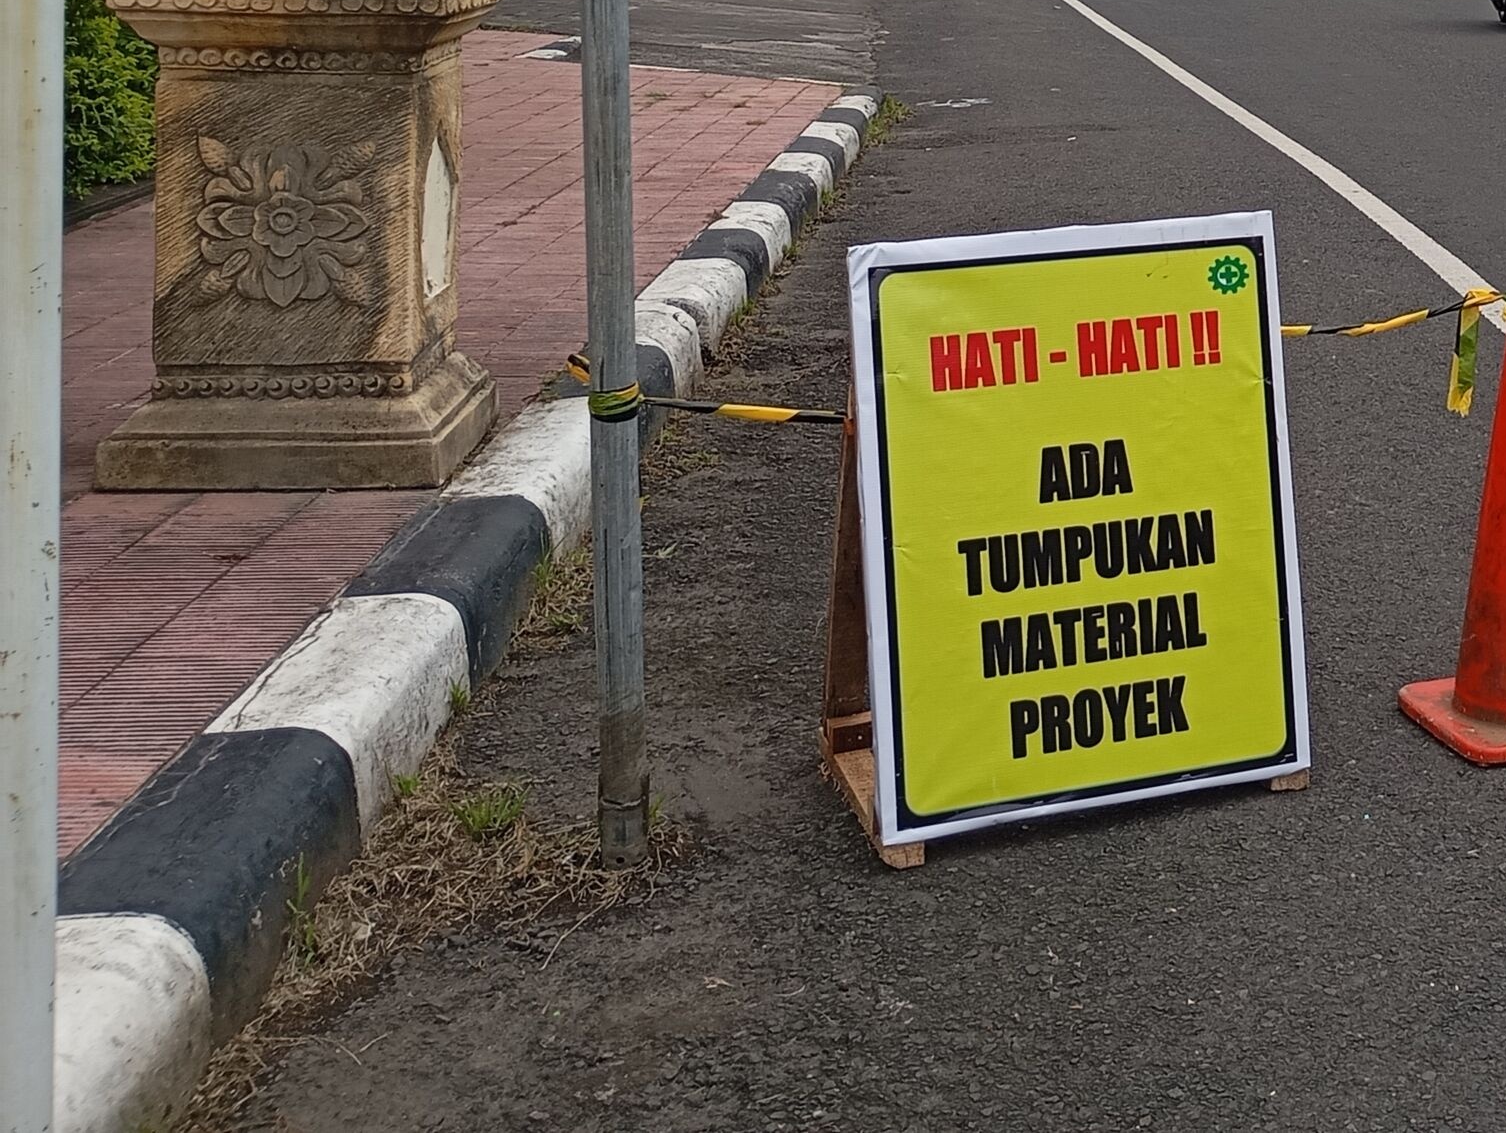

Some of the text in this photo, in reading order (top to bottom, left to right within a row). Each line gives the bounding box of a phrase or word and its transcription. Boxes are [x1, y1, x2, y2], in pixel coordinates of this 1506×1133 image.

[929, 327, 1040, 393] HATI
[1076, 313, 1181, 378] HATI
[1039, 439, 1134, 504] ADA
[957, 509, 1216, 596] TUMPUKAN
[980, 592, 1208, 679] MATERIAL
[1010, 675, 1190, 759] PROYEK
